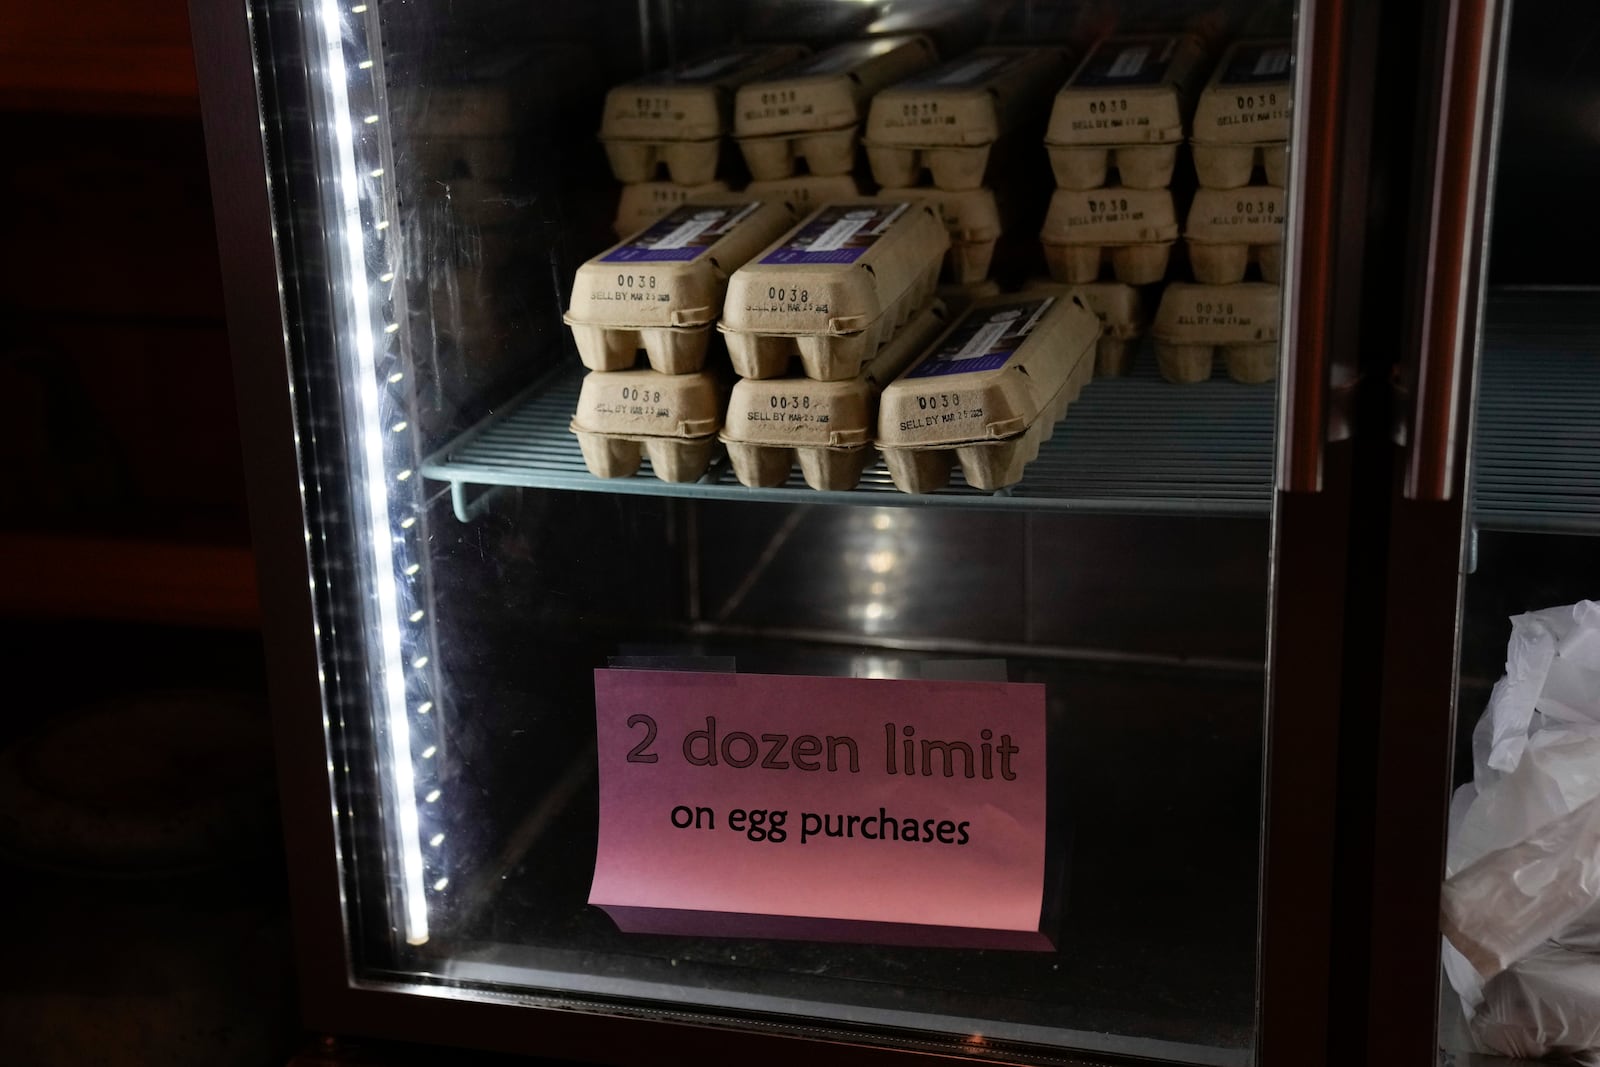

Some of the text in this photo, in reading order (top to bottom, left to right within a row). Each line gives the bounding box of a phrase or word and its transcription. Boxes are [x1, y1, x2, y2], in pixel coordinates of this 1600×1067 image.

[1090, 99, 1127, 113] 0038
[1237, 94, 1276, 109] 0038
[1236, 201, 1274, 214] 0038
[617, 274, 656, 289] 0038
[591, 292, 613, 300] SELL
[615, 291, 627, 300] BY
[630, 293, 643, 301] MAR
[769, 287, 808, 303] 0038
[787, 303, 801, 312] MAR
[623, 387, 660, 403] 0038
[770, 396, 810, 409] 0038
[918, 393, 960, 410] 0038
[747, 411, 771, 421] SELL
[773, 412, 786, 422] BY
[900, 419, 924, 431] SELL
[925, 414, 939, 426] BY
[941, 413, 955, 423] MAR
[626, 713, 1020, 782] 2 dozen limit
[670, 804, 971, 846] on egg purchases
